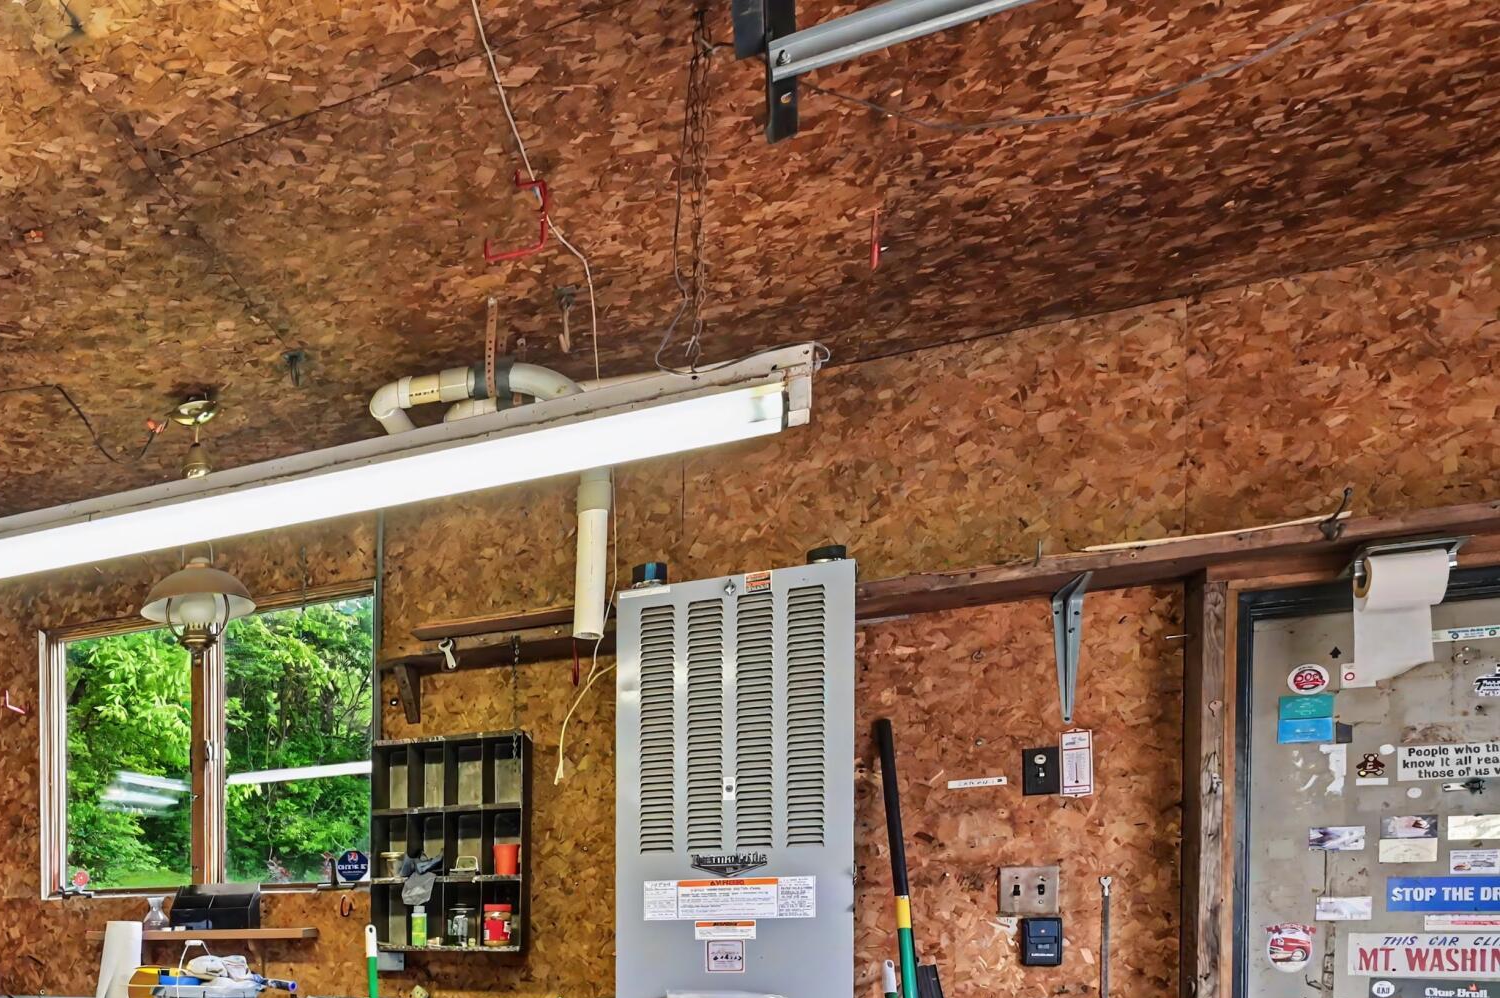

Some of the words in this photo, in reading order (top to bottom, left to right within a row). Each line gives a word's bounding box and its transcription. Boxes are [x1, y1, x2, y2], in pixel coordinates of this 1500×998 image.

[1408, 746, 1449, 757] People
[1454, 744, 1481, 755] who
[1402, 760, 1435, 768] know
[1418, 769, 1454, 779] those
[1458, 767, 1471, 777] of
[1391, 887, 1437, 902] STOP
[1442, 886, 1475, 901] THE
[1382, 936, 1418, 946] THIS
[1428, 936, 1460, 946] CAR
[1473, 936, 1500, 946] CLI
[1358, 947, 1397, 972] MT.
